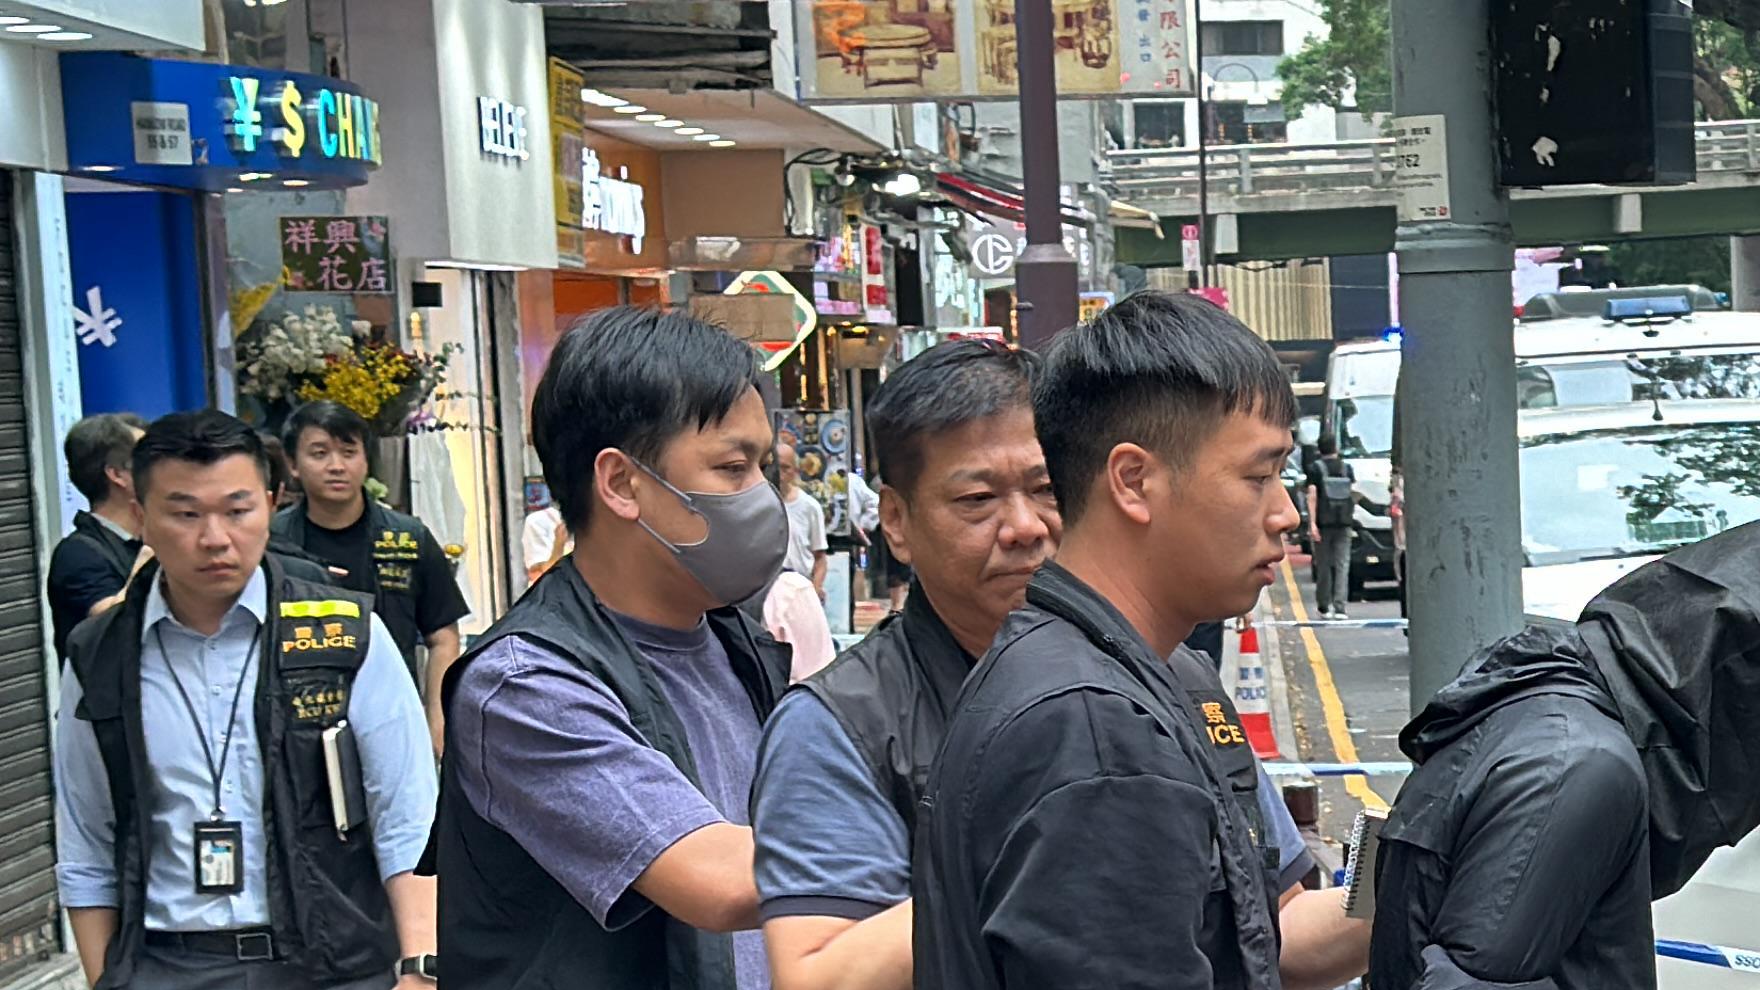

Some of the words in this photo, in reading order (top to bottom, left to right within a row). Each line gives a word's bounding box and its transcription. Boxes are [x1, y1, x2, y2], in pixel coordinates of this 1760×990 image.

[1159, 0, 1182, 89] 限公司
[281, 80, 305, 158] $
[285, 219, 360, 254] 祥興
[318, 256, 386, 291] 花店
[282, 635, 357, 653] POLICE
